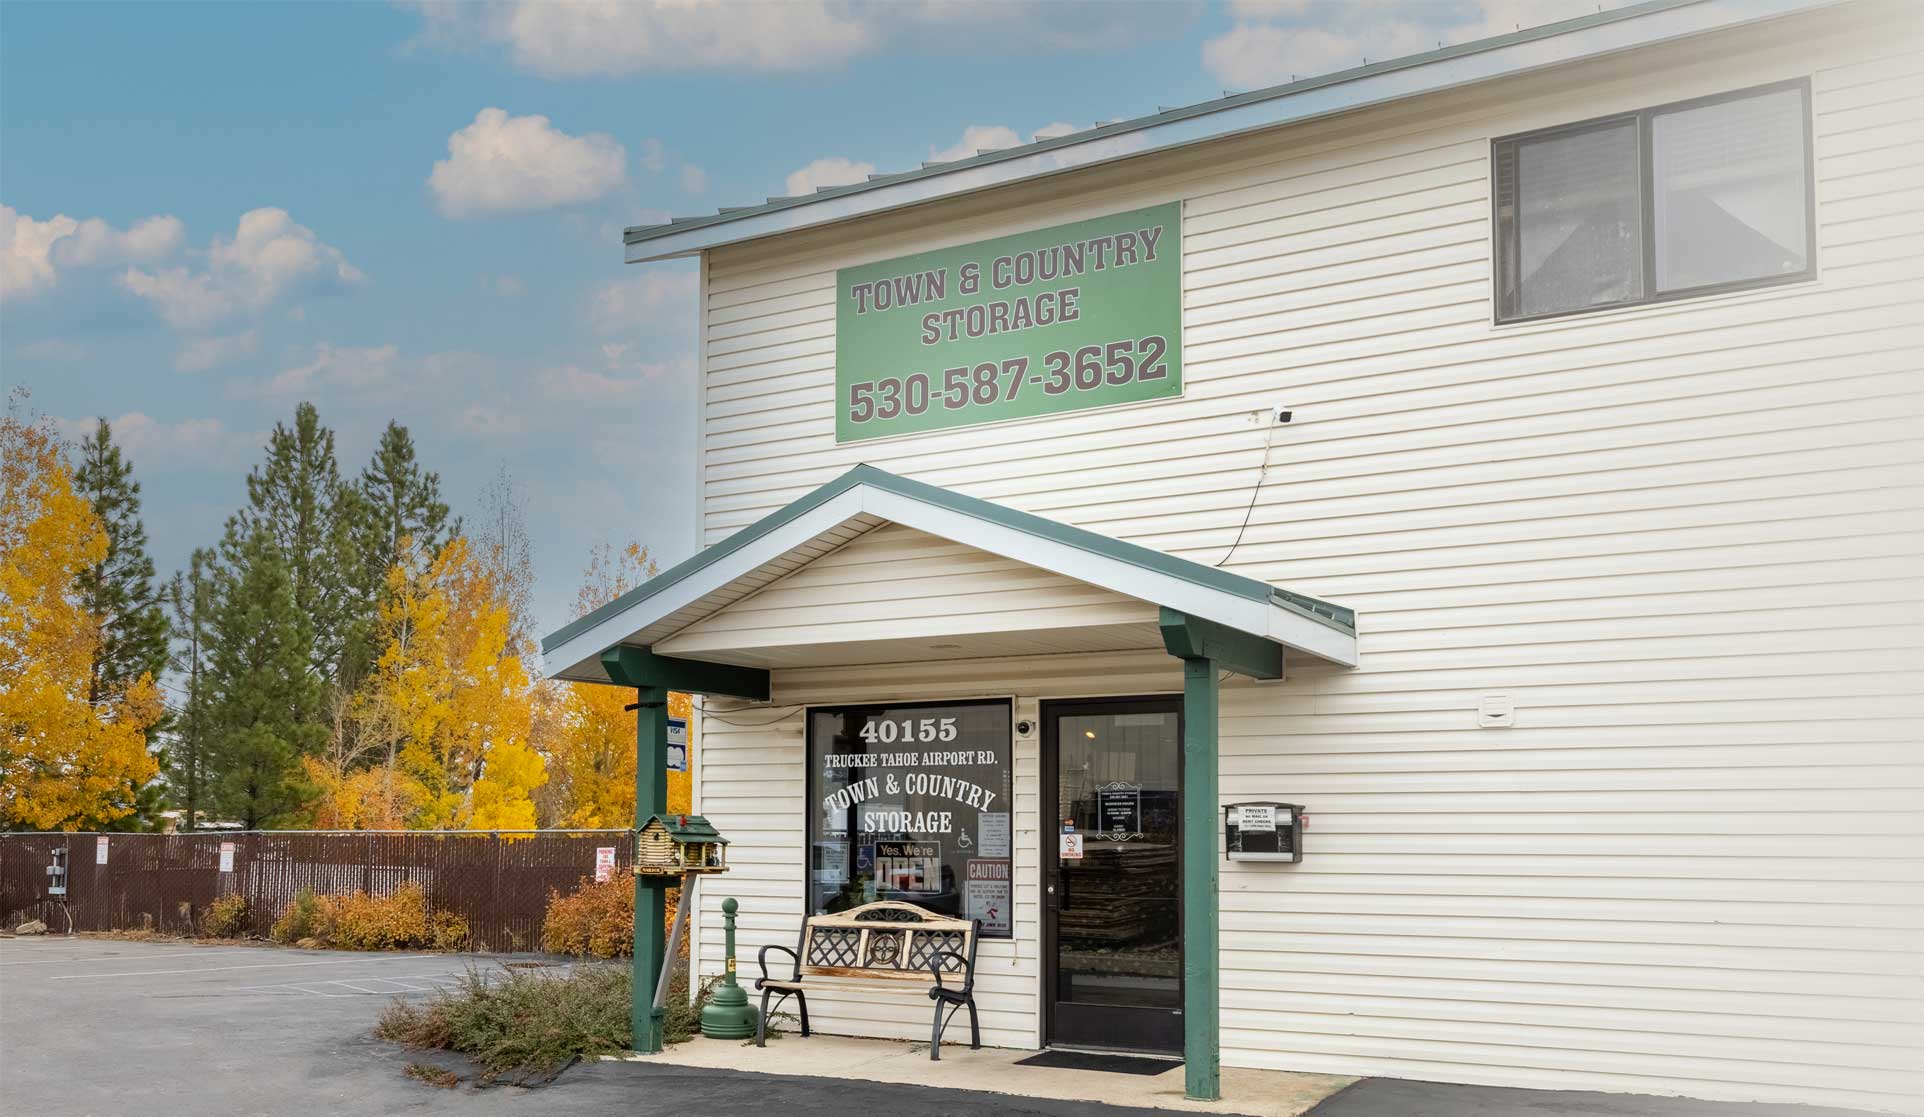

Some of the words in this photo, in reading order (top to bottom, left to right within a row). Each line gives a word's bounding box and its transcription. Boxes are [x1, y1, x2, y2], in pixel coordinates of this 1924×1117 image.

[851, 268, 948, 315] TOWN
[958, 262, 980, 296] &
[991, 225, 1163, 290] COUNTRY
[921, 287, 1081, 345] STORAGE
[850, 335, 1167, 424] 530-587-3652
[859, 718, 958, 743] 40155
[824, 753, 878, 768] TRUCKEE
[880, 752, 919, 767] TAHOE
[921, 751, 975, 766] AIRPORT
[977, 750, 998, 765] RD.
[824, 776, 879, 814] TOWN
[885, 773, 900, 795] &
[905, 773, 997, 813] COUNTRY
[864, 811, 952, 833] STORAGE
[902, 844, 934, 856] We're
[876, 858, 940, 890] OPEN
[969, 863, 1009, 879] CAUTION
